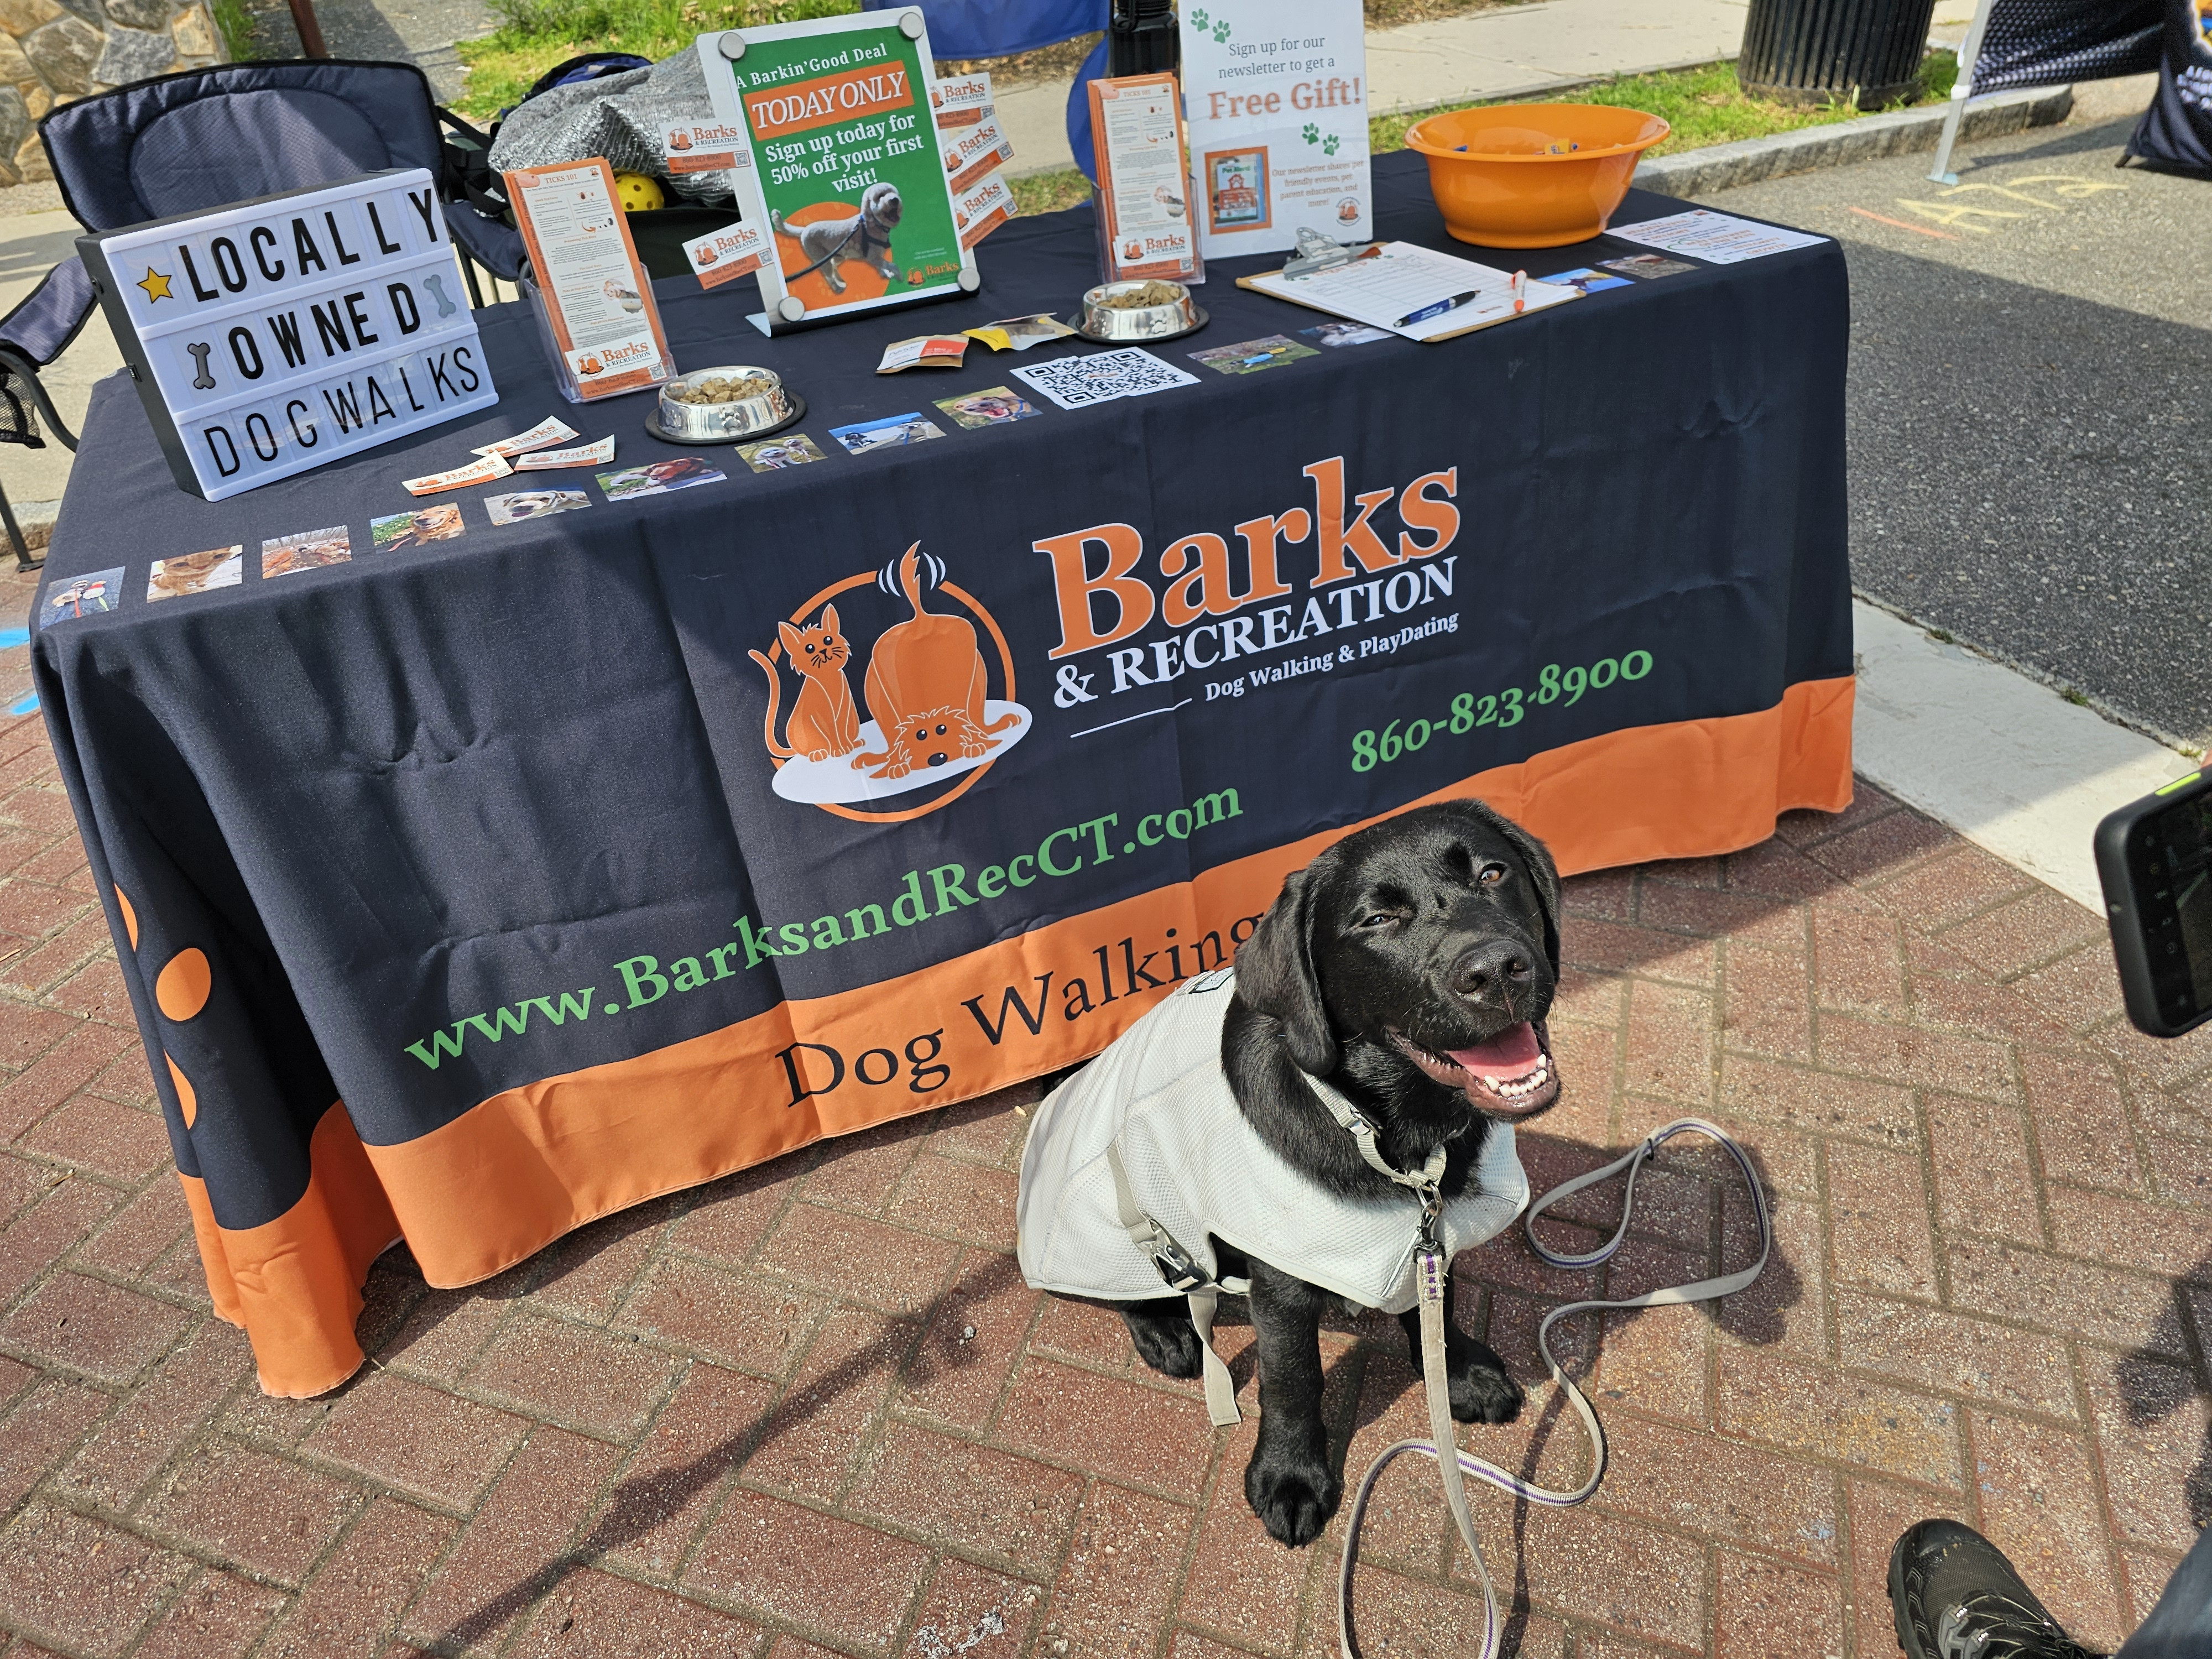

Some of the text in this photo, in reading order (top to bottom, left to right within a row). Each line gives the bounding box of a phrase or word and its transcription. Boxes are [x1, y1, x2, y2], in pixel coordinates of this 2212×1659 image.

[1229, 37, 1325, 58] Sign up for our
[737, 76, 747, 88] A
[853, 43, 887, 61] Deal
[1219, 58, 1334, 79] newsletter to get a
[752, 71, 905, 128] TODAY ONLY
[943, 81, 985, 97] Barks
[951, 93, 985, 102] RECREATION
[1208, 77, 1360, 119] Free Gift!
[692, 124, 737, 140] Barks
[765, 141, 806, 163] Sign
[808, 135, 833, 154] up
[836, 122, 885, 145] today
[889, 115, 915, 132] for
[958, 126, 995, 153] Barks
[771, 135, 924, 184] 50% off your first
[1288, 165, 1326, 175] newsletter
[1328, 162, 1350, 170] shares
[1352, 160, 1364, 169] pet
[545, 175, 565, 184] TICKS
[832, 168, 878, 192] visit!
[1285, 177, 1312, 187] friendly
[1341, 174, 1353, 182] pet
[963, 183, 1000, 211] Barks
[1280, 191, 1305, 201] parent
[1306, 186, 1343, 196] education,
[179, 189, 438, 302] LOCALLY
[714, 228, 757, 250] Barks
[725, 238, 759, 254] RECREATION
[1145, 234, 1185, 249] Barks
[926, 261, 959, 275] Barks
[228, 282, 421, 380] OWNED
[601, 342, 649, 362] Barks
[612, 351, 651, 366] RECREATION
[510, 425, 555, 445] Barks
[559, 444, 607, 457] Barks
[445, 460, 495, 479] Barks
[1032, 456, 1460, 660] Barks
[1053, 556, 1458, 708] & RECREATION
[1204, 613, 1459, 701] Dog Walking & PlayDating
[1351, 650, 1653, 772] 860-823-8900
[404, 787, 1243, 1071] www.BarksandRecCT.com
[775, 1027, 951, 1108] Dog
